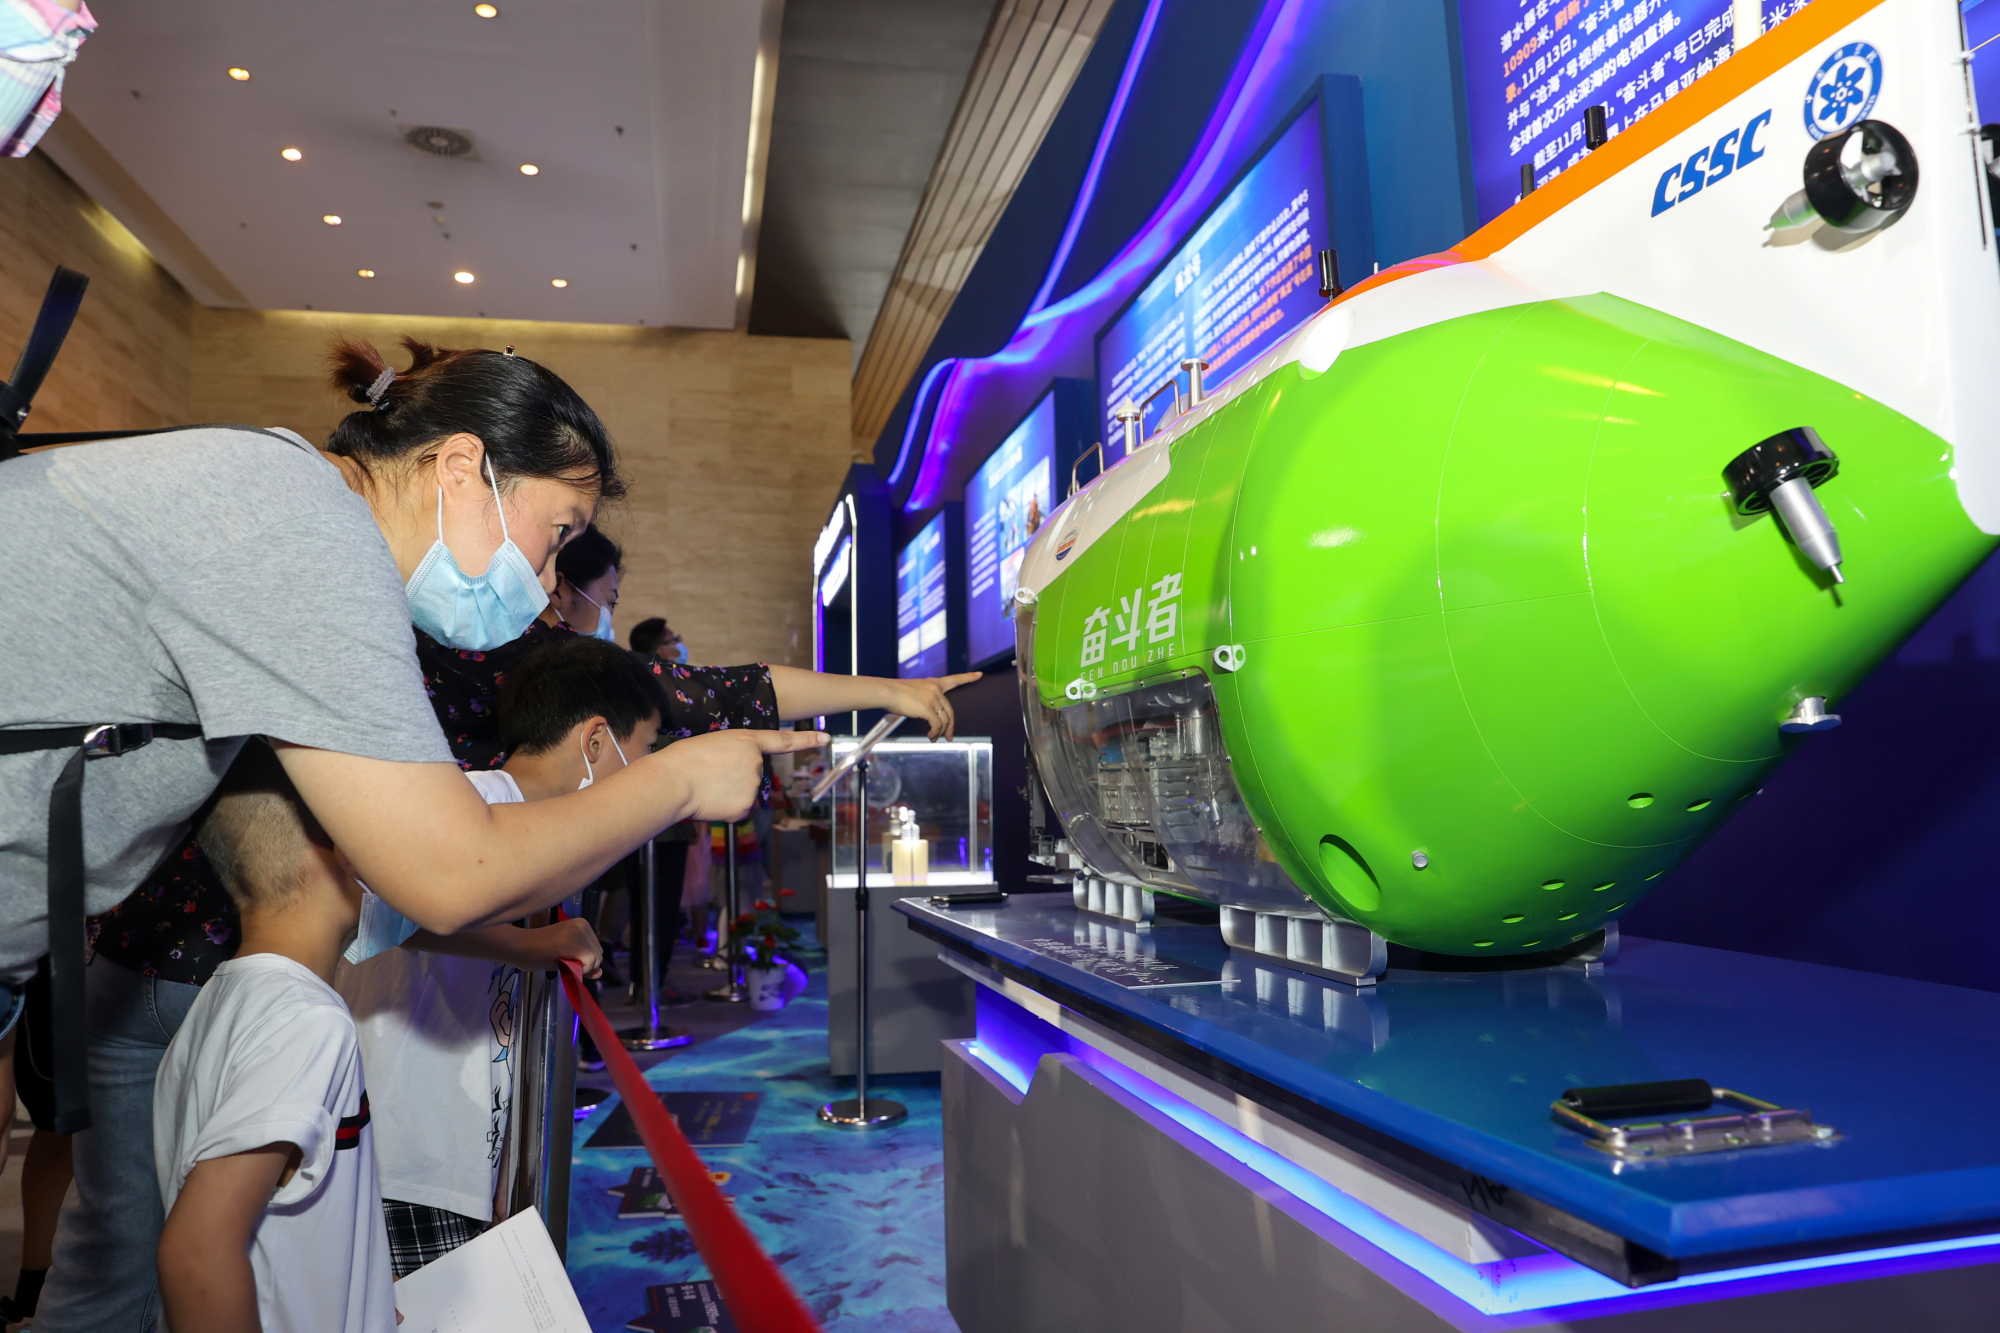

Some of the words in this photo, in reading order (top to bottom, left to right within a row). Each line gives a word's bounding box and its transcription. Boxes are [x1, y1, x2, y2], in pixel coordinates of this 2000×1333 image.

[1651, 109, 1772, 218] CSSC
[1080, 571, 1182, 668] 奋斗者
[1112, 655, 1138, 674] DOU
[1147, 642, 1176, 663] ZHE
